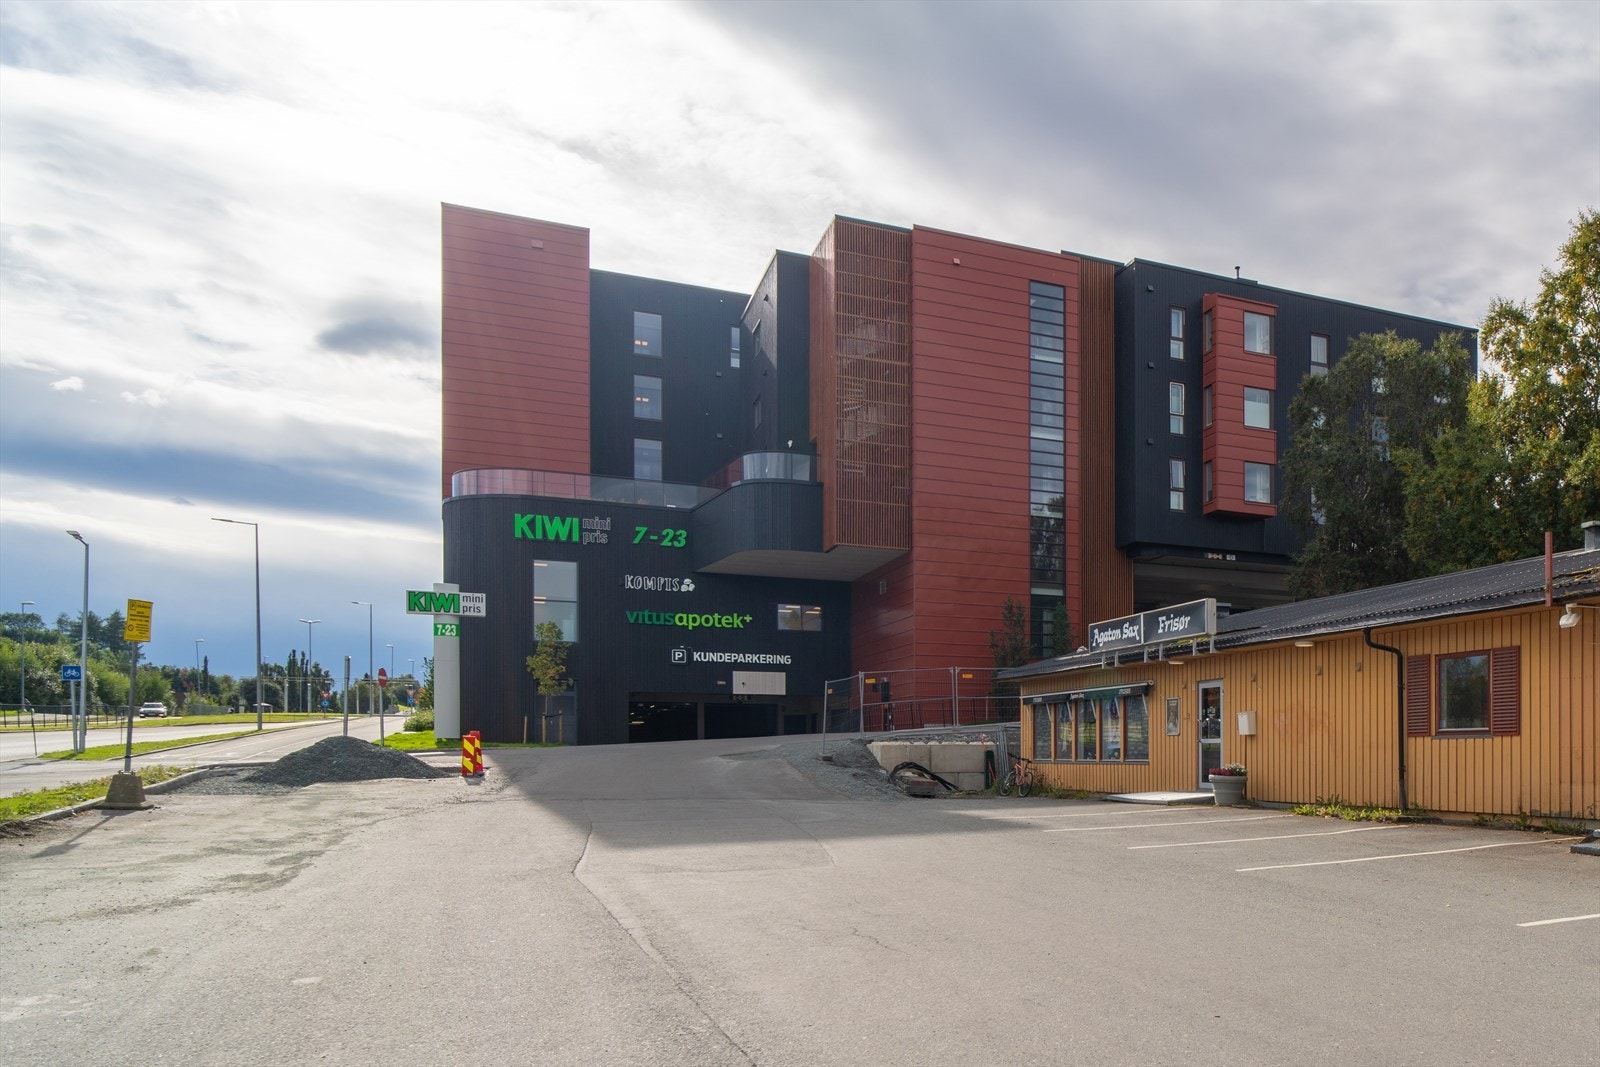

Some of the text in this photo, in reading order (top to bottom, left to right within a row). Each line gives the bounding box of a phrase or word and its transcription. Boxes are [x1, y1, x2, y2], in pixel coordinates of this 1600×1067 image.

[514, 513, 579, 542] KIWI
[582, 516, 611, 531] mini
[582, 531, 609, 545] pris
[624, 574, 680, 592] KOMPIS
[408, 591, 460, 613] KIWI
[462, 594, 484, 603] mini
[462, 604, 482, 614] pris
[436, 624, 457, 636] 7-23
[1157, 614, 1190, 634] Frisør
[1092, 621, 1140, 647] Agaton Sax
[693, 651, 792, 665] KUNDEPARKERING
